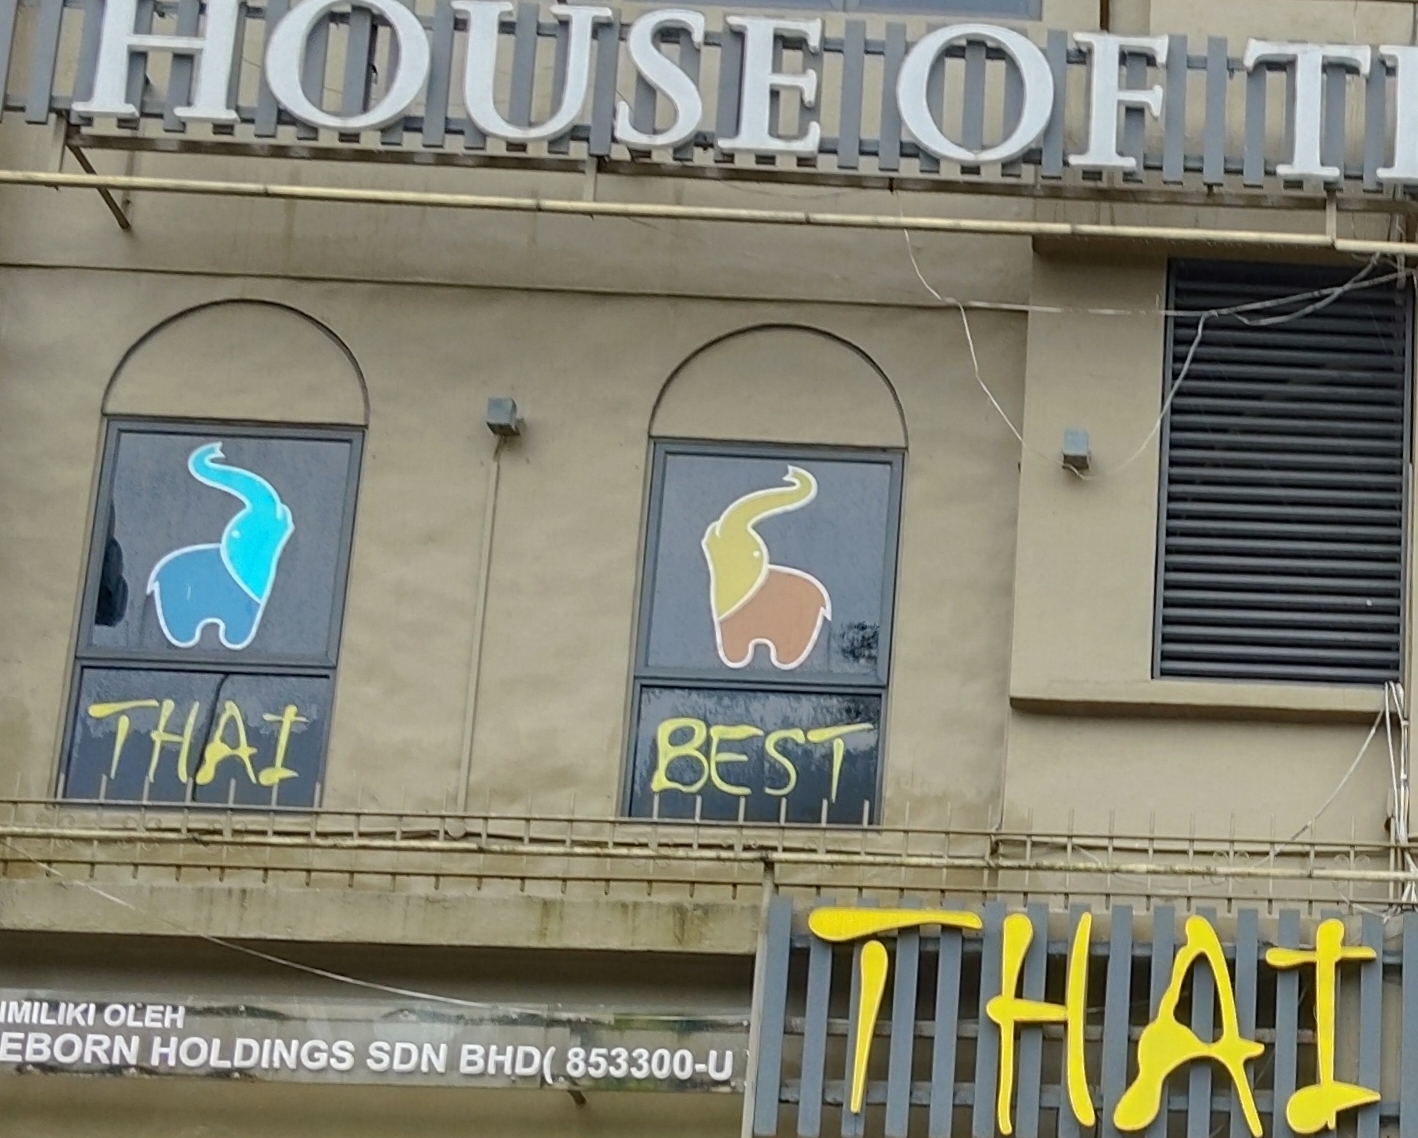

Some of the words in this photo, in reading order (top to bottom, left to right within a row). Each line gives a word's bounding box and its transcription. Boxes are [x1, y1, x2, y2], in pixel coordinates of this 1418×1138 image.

[72, 0, 824, 157] HOUSE
[896, 22, 1170, 171] OF
[87, 698, 309, 787] THAI
[652, 716, 876, 803] BEST
[0, 1031, 140, 1066] EBORN
[151, 1036, 355, 1072] HOLDINGS
[366, 1041, 448, 1075] SDN
[103, 1003, 186, 1029] OLEH
[807, 907, 1382, 1138] THAI
